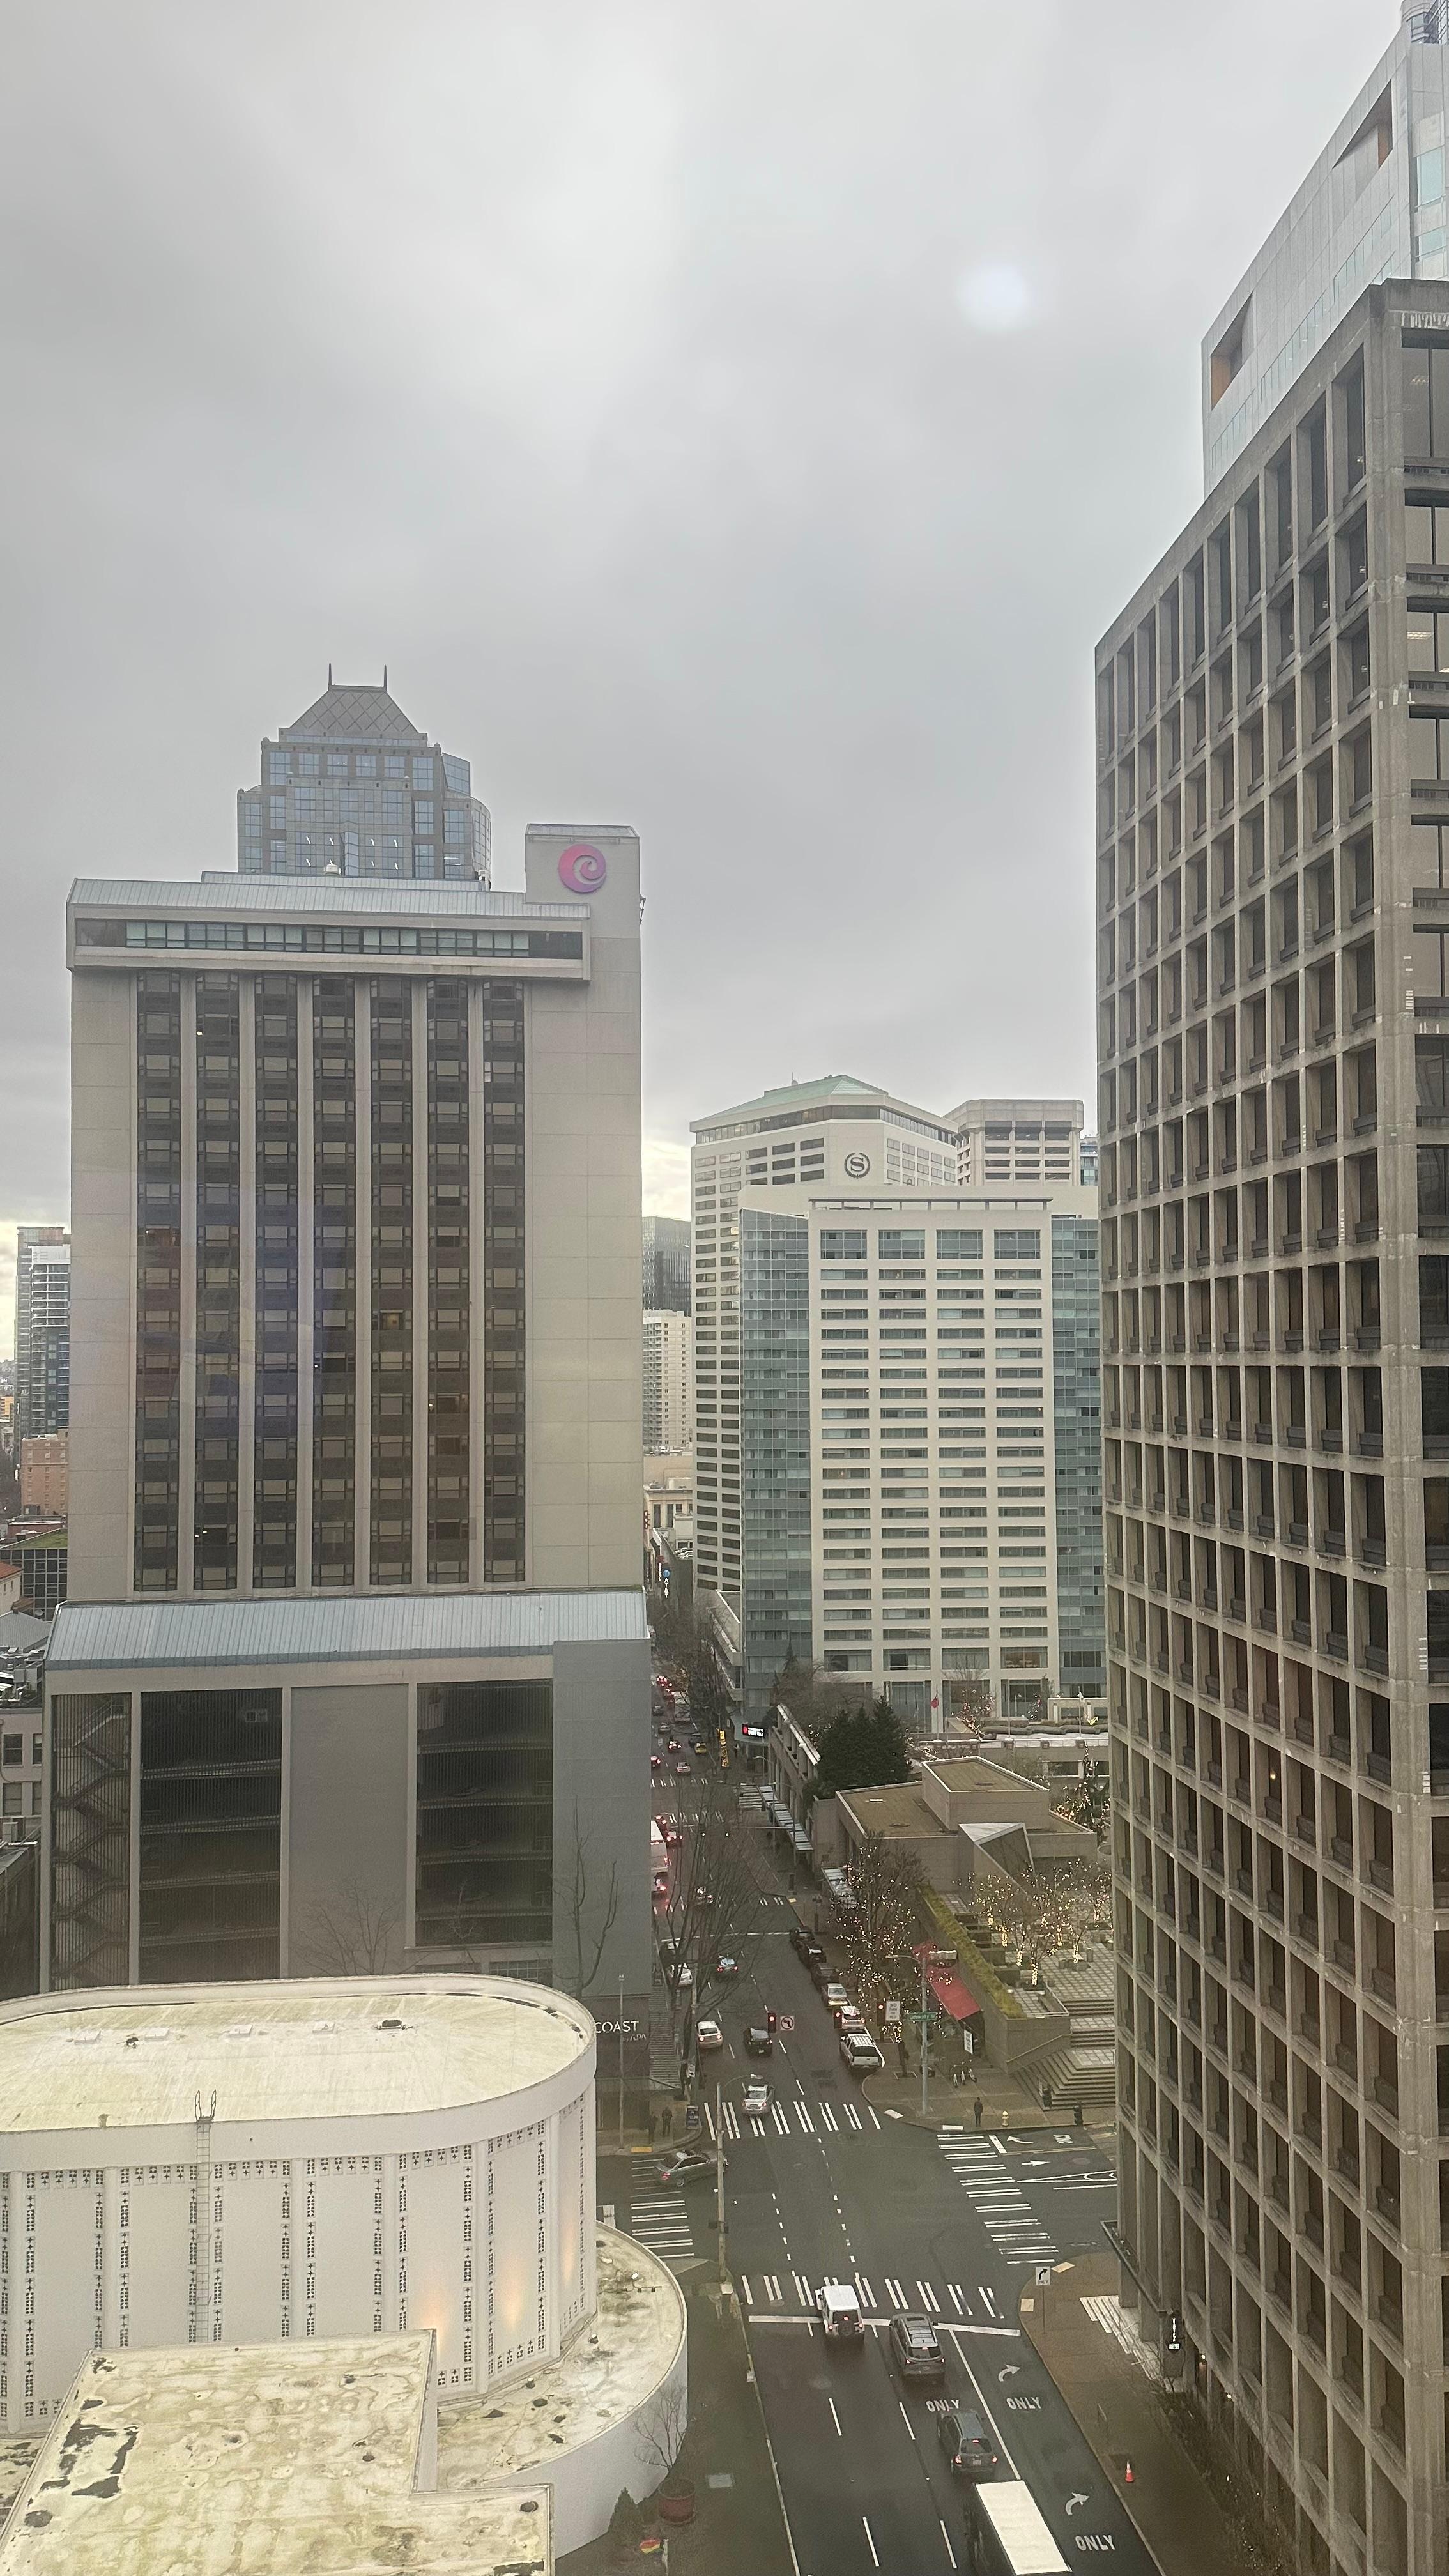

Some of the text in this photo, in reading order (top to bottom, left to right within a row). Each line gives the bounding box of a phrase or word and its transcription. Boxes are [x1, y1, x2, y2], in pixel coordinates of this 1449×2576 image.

[595, 2020, 640, 2034] COAST
[1006, 2396, 1042, 2409] ONLY
[1075, 2534, 1116, 2551] ONLY
